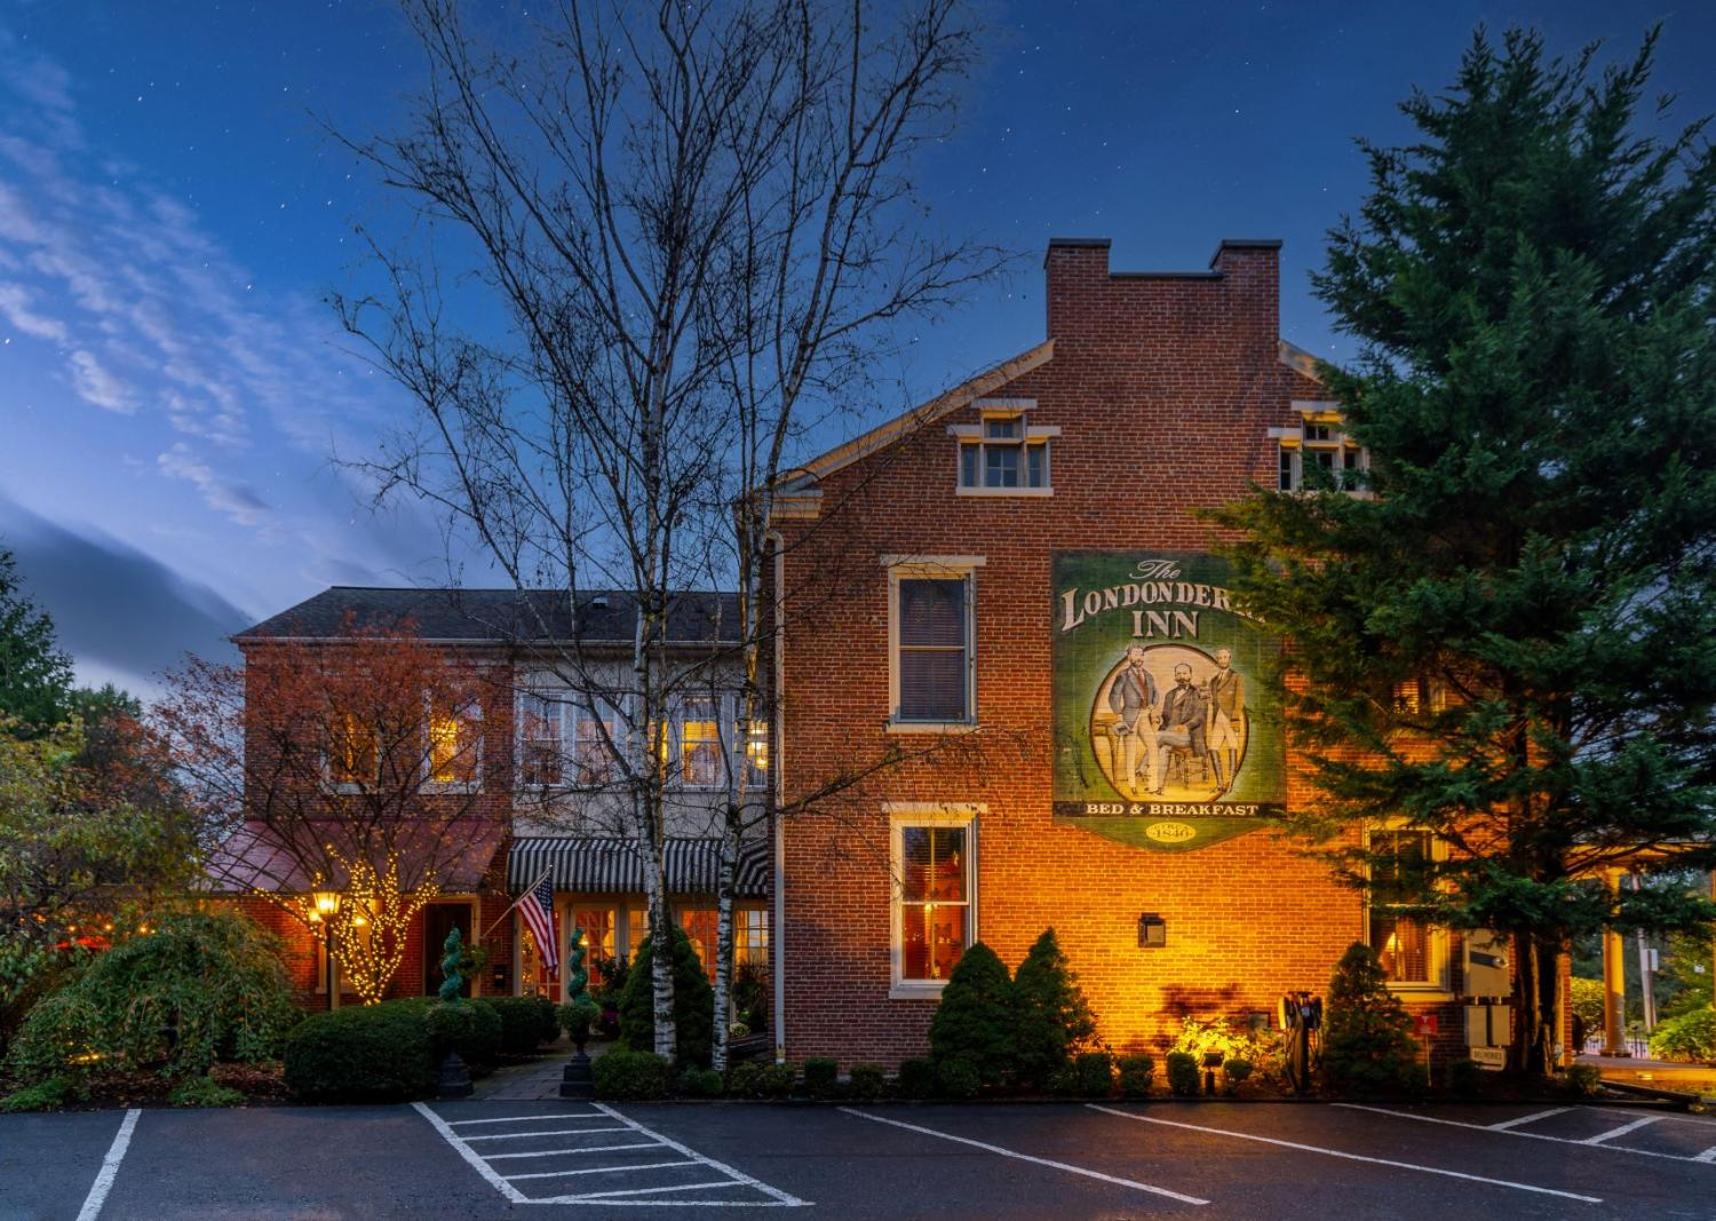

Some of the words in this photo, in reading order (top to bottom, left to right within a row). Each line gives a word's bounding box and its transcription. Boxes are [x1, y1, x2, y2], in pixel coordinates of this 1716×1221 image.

[1129, 559, 1182, 580] The
[1062, 582, 1268, 632] LONDONDER
[1132, 611, 1198, 637] INN
[1086, 804, 1124, 815] BED
[1130, 804, 1144, 815] &
[1149, 804, 1259, 816] BREAKFAST
